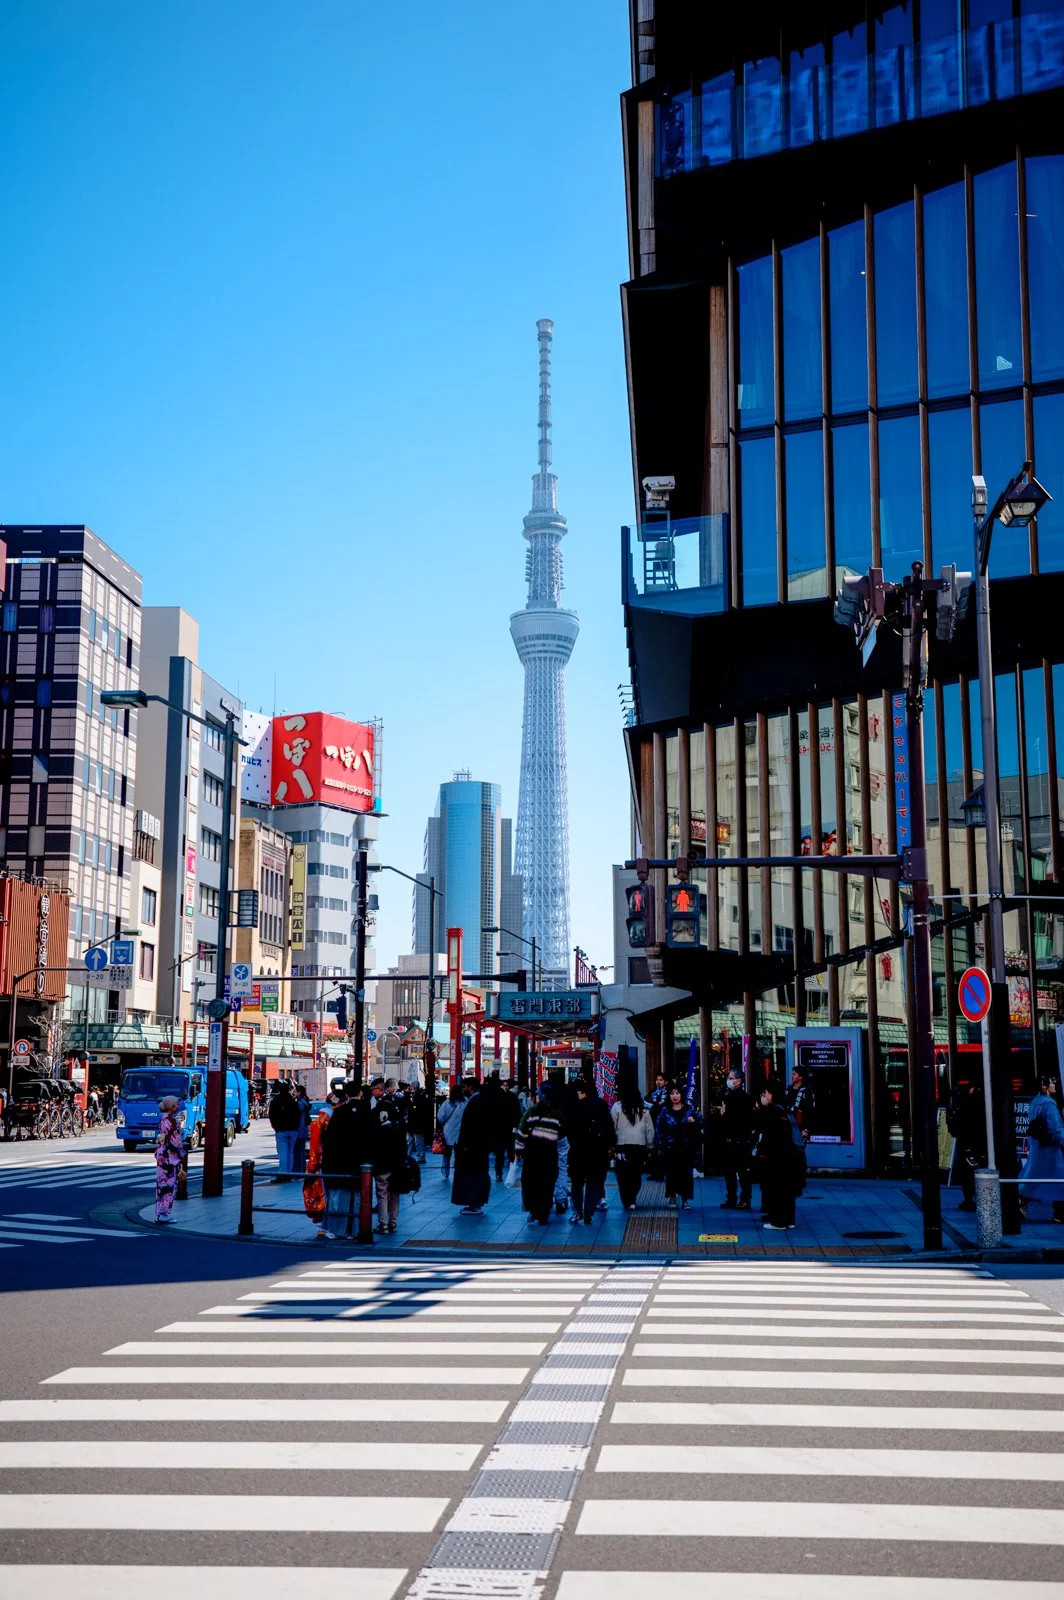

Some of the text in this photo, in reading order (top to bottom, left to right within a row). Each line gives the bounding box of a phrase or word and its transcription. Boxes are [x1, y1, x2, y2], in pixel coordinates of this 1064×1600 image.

[275, 715, 314, 800] つぼ八
[325, 745, 373, 776] つぼ八
[510, 997, 580, 1013] 雷門東部
